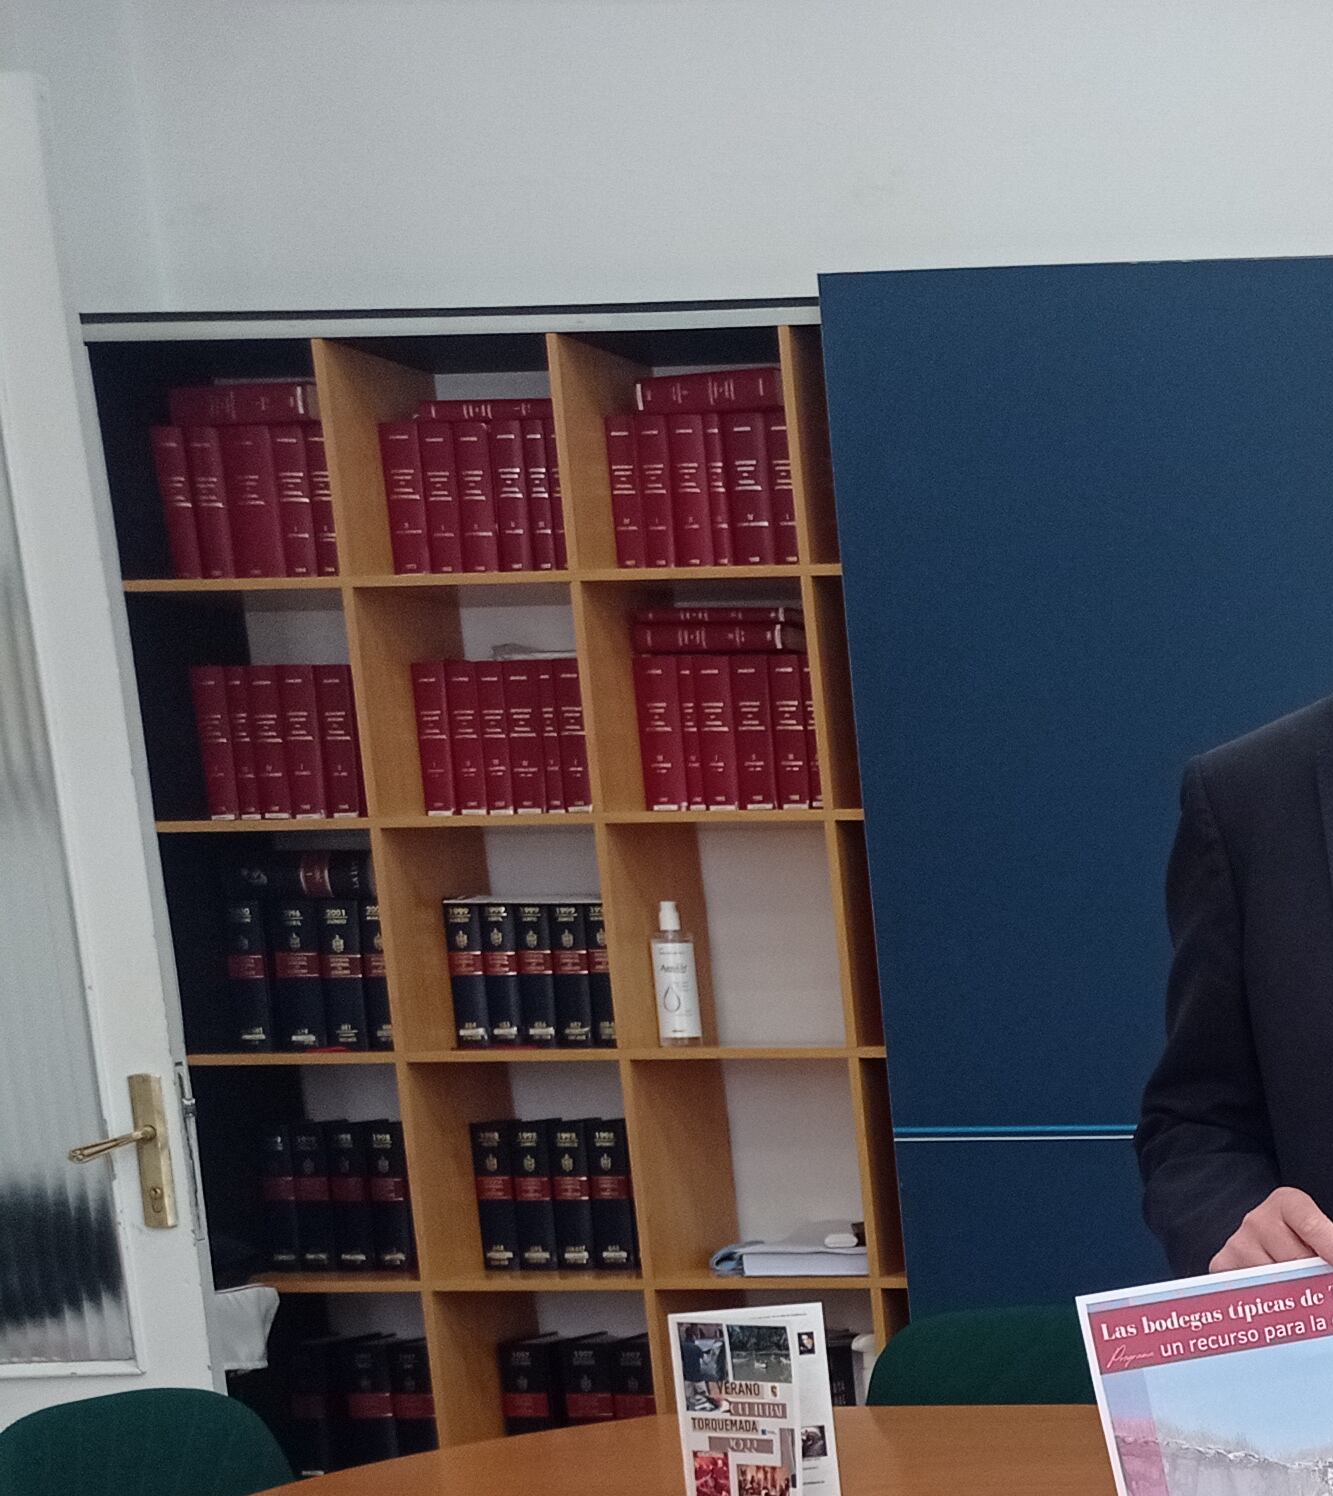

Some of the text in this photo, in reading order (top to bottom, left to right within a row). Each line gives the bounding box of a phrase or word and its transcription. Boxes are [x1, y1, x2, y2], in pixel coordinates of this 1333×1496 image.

[1102, 1323, 1137, 1340] Las
[1142, 1309, 1223, 1333] bodegas
[1228, 1297, 1295, 1322] típicas
[1300, 1288, 1324, 1307] de
[1161, 1341, 1184, 1357] un
[1189, 1330, 1259, 1352] recurso
[1263, 1321, 1305, 1343] para
[1309, 1314, 1327, 1331] la
[717, 1383, 760, 1395] VERANO
[691, 1417, 758, 1432] TORQUEMADA
